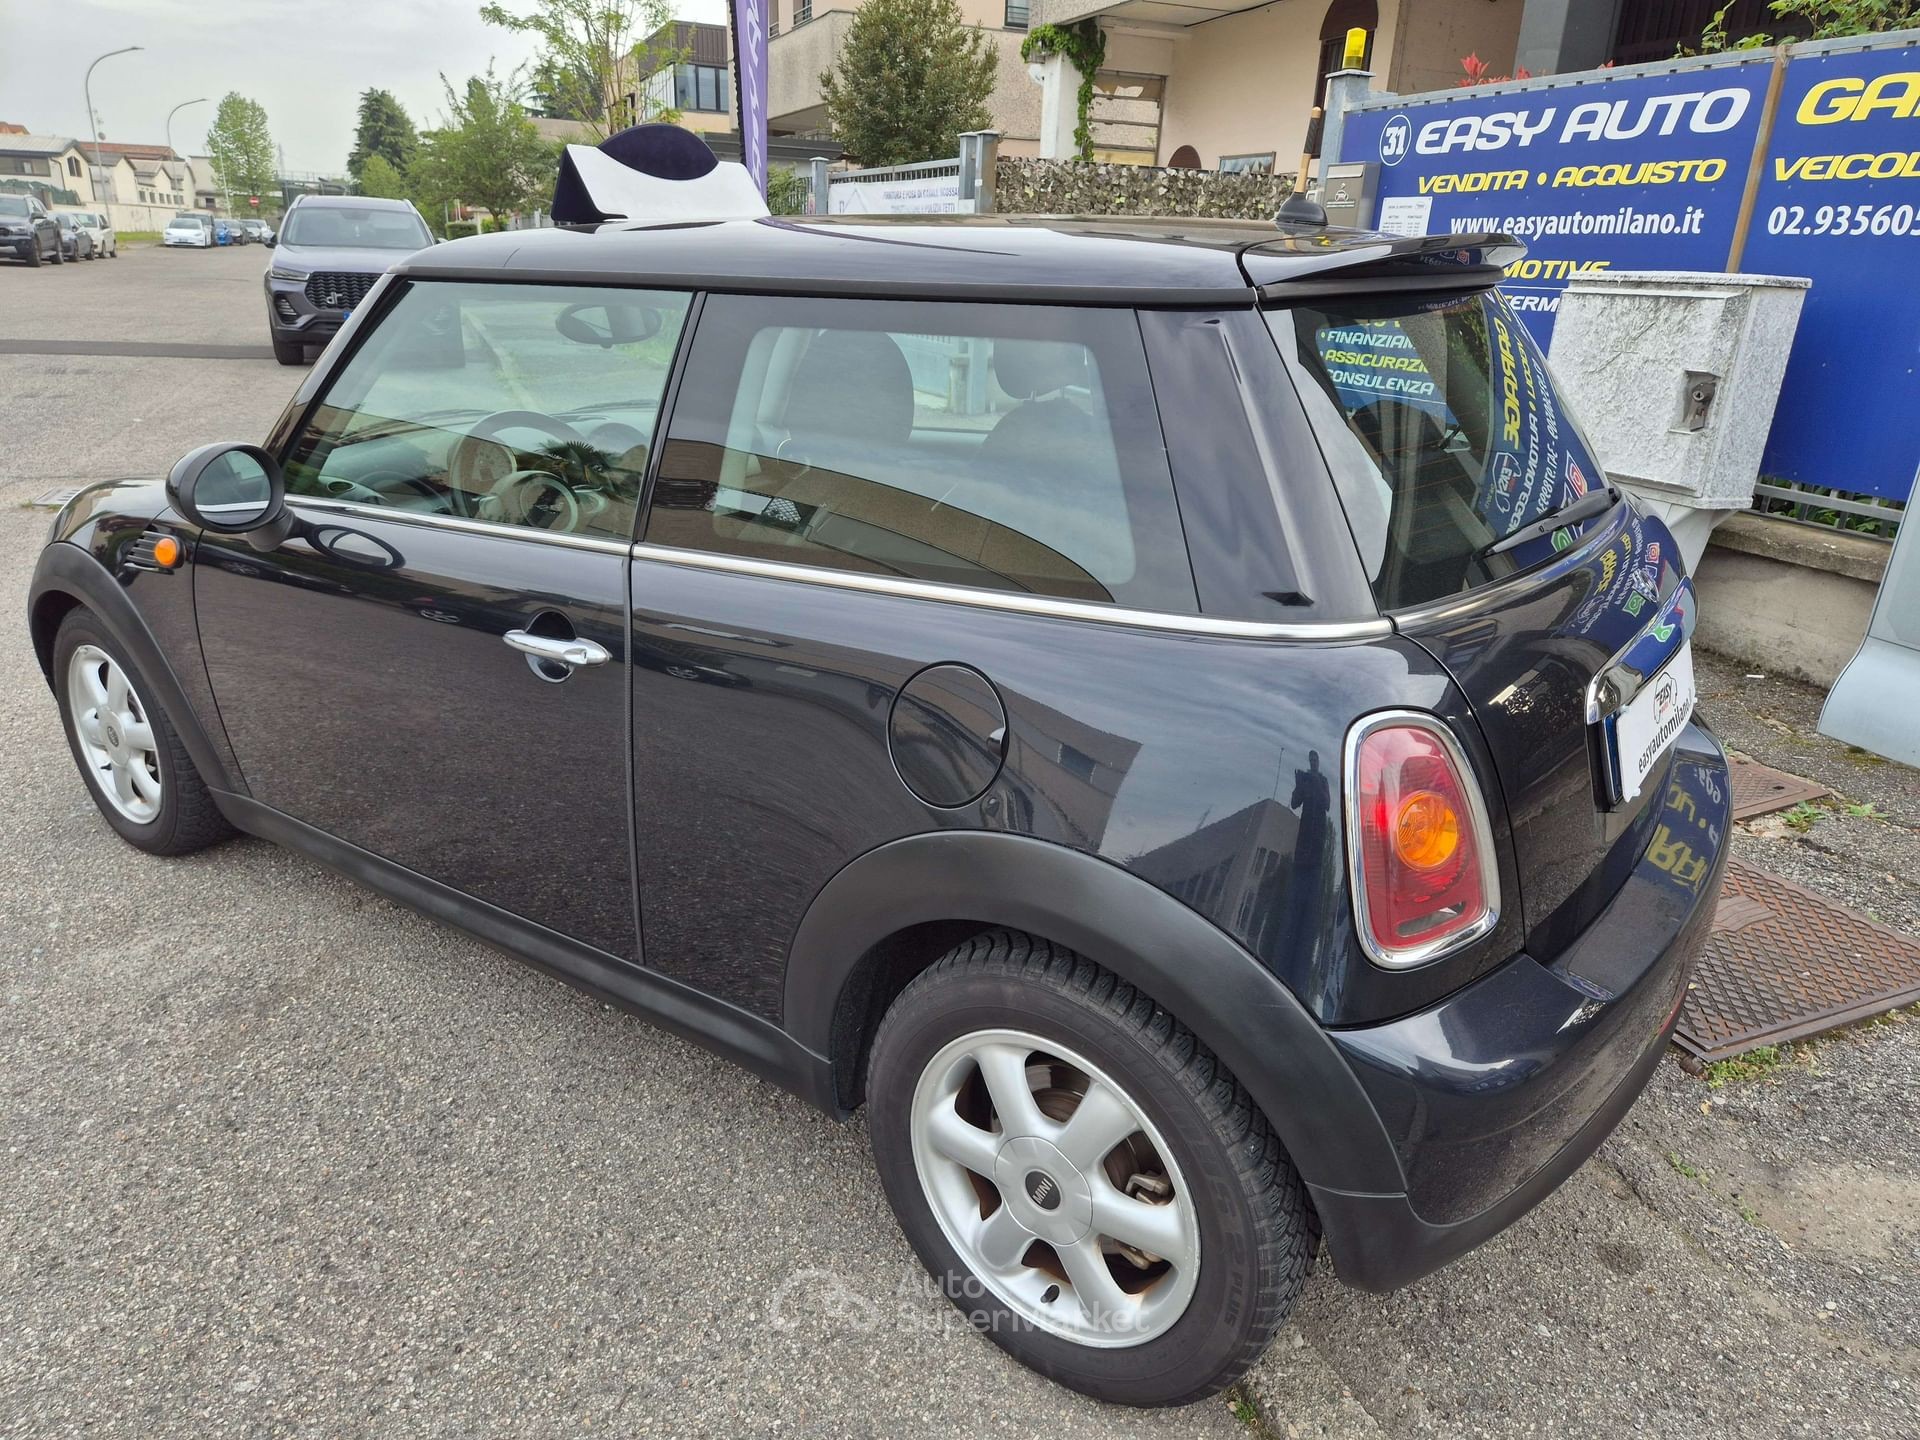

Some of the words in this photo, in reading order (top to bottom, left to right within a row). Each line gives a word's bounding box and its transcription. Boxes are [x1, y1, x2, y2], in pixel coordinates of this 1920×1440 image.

[1796, 71, 1920, 125] GA
[1383, 125, 1403, 156] 31
[1415, 107, 1556, 155] EASY
[1559, 87, 1751, 144] AUTO
[1418, 170, 1529, 194] VENDITA
[1552, 158, 1727, 188] ACQUISTO
[1775, 151, 1920, 182] VEICOL
[1450, 206, 1705, 241] www.easyautomilano.it
[1503, 259, 1610, 279] MOTIVE
[1508, 295, 1560, 312] ERM
[1032, 1177, 1053, 1204] MINI
